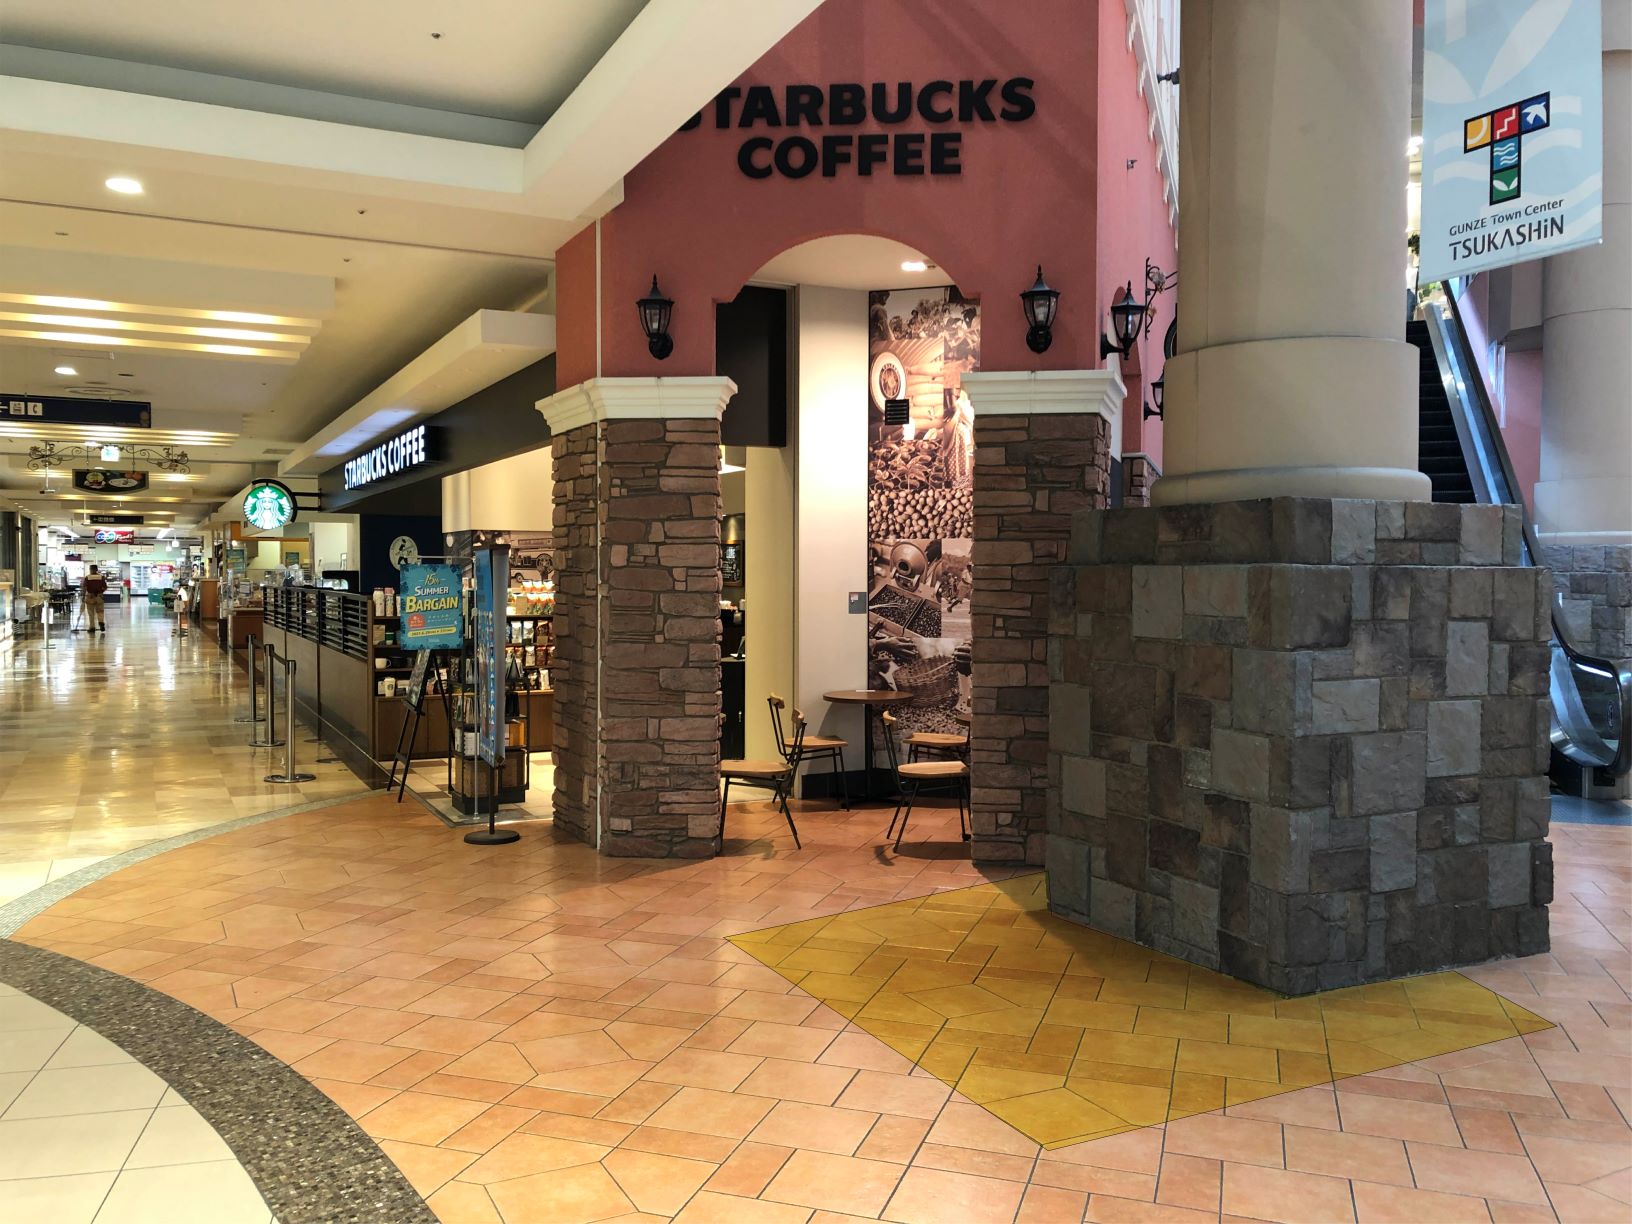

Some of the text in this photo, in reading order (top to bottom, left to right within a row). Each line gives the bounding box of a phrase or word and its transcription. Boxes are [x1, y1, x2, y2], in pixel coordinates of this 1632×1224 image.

[737, 132, 962, 179] COFFEE
[1449, 199, 1564, 236] GUNZE Town Center
[344, 424, 426, 490] STARBUCKS COFFEE
[405, 595, 459, 613] BARGAIN
[414, 585, 449, 596] SUMMER
